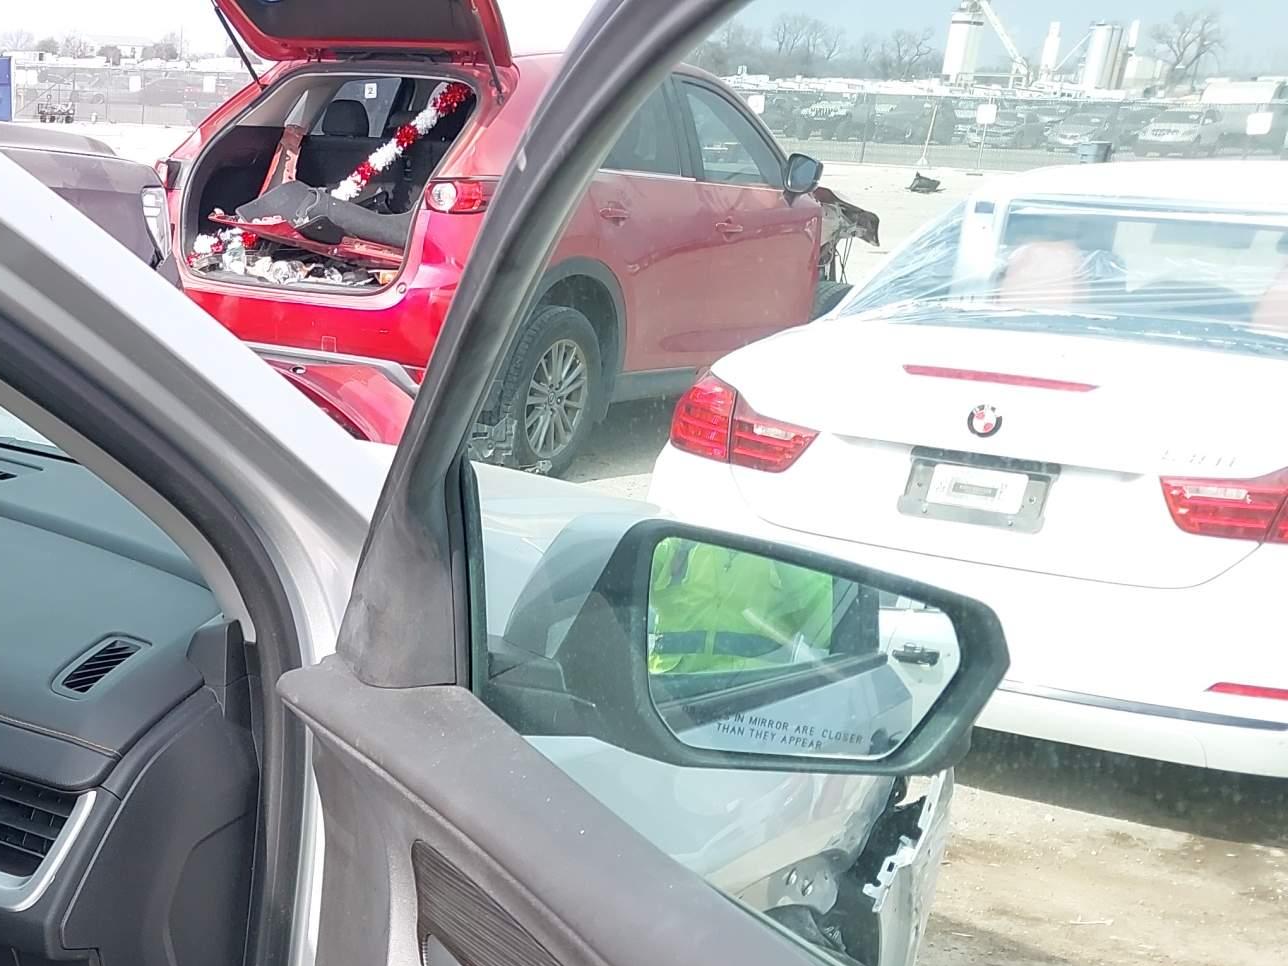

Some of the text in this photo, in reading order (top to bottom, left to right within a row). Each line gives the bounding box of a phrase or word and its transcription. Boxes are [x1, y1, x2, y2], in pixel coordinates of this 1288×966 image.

[717, 722, 823, 751] THAN THEY APPEAR
[734, 711, 746, 724] IN
[749, 716, 789, 731] MIRROR
[794, 725, 815, 736] ARE
[821, 729, 863, 744] CLOSER
